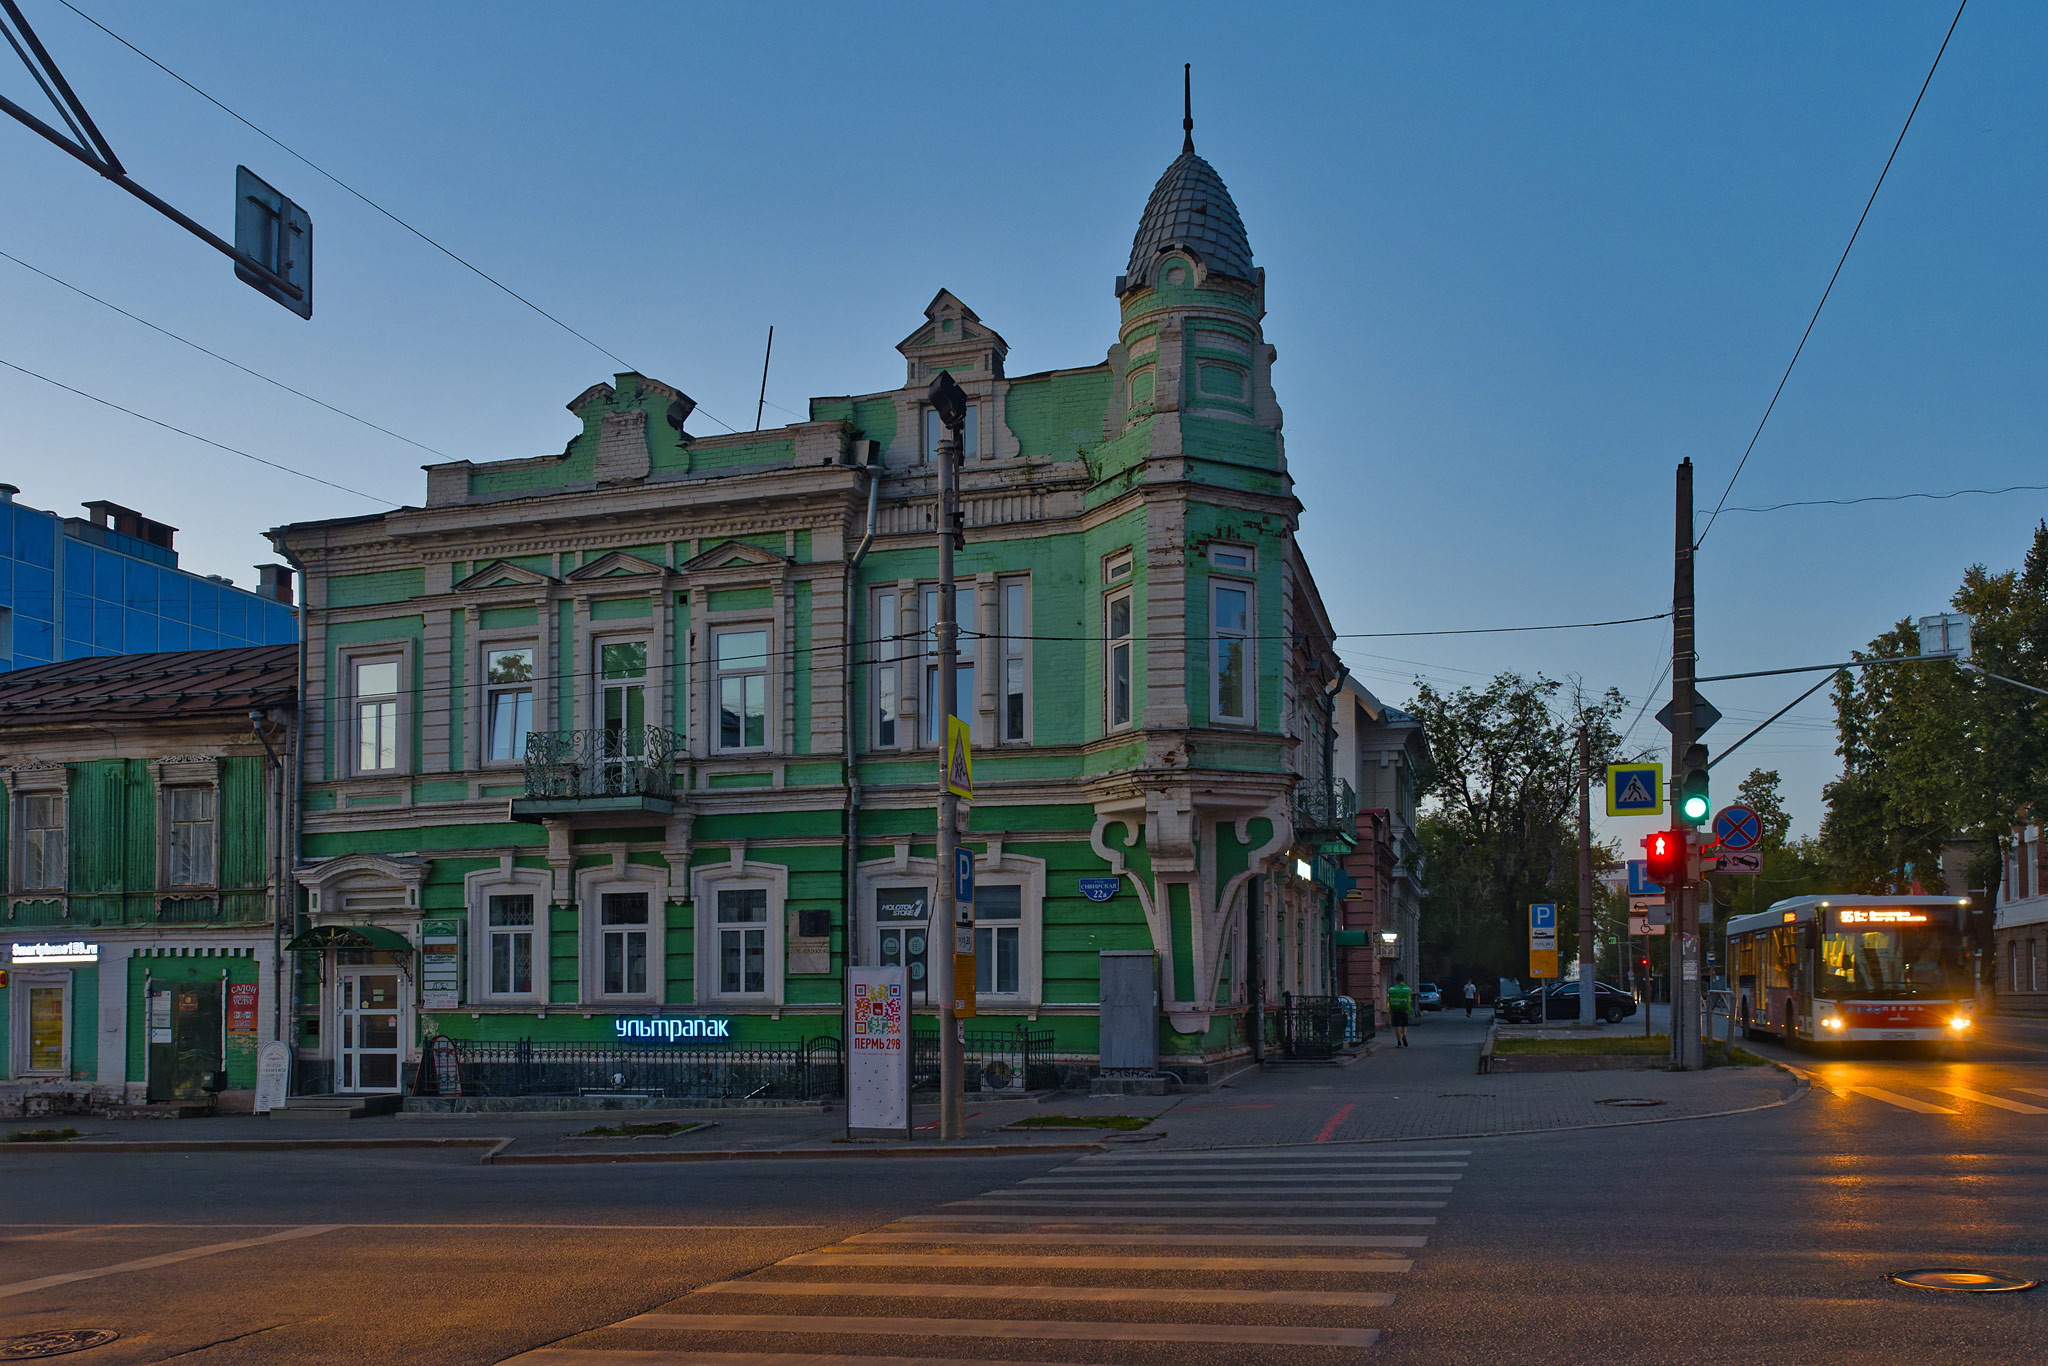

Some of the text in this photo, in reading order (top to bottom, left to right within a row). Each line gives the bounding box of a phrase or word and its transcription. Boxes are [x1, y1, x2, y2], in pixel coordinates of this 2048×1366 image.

[1537, 906, 1550, 925] P
[231, 984, 257, 993] САЛОН
[615, 1019, 729, 1042] ультрапак
[854, 1038, 901, 1050] ПЕРМЬ 298
